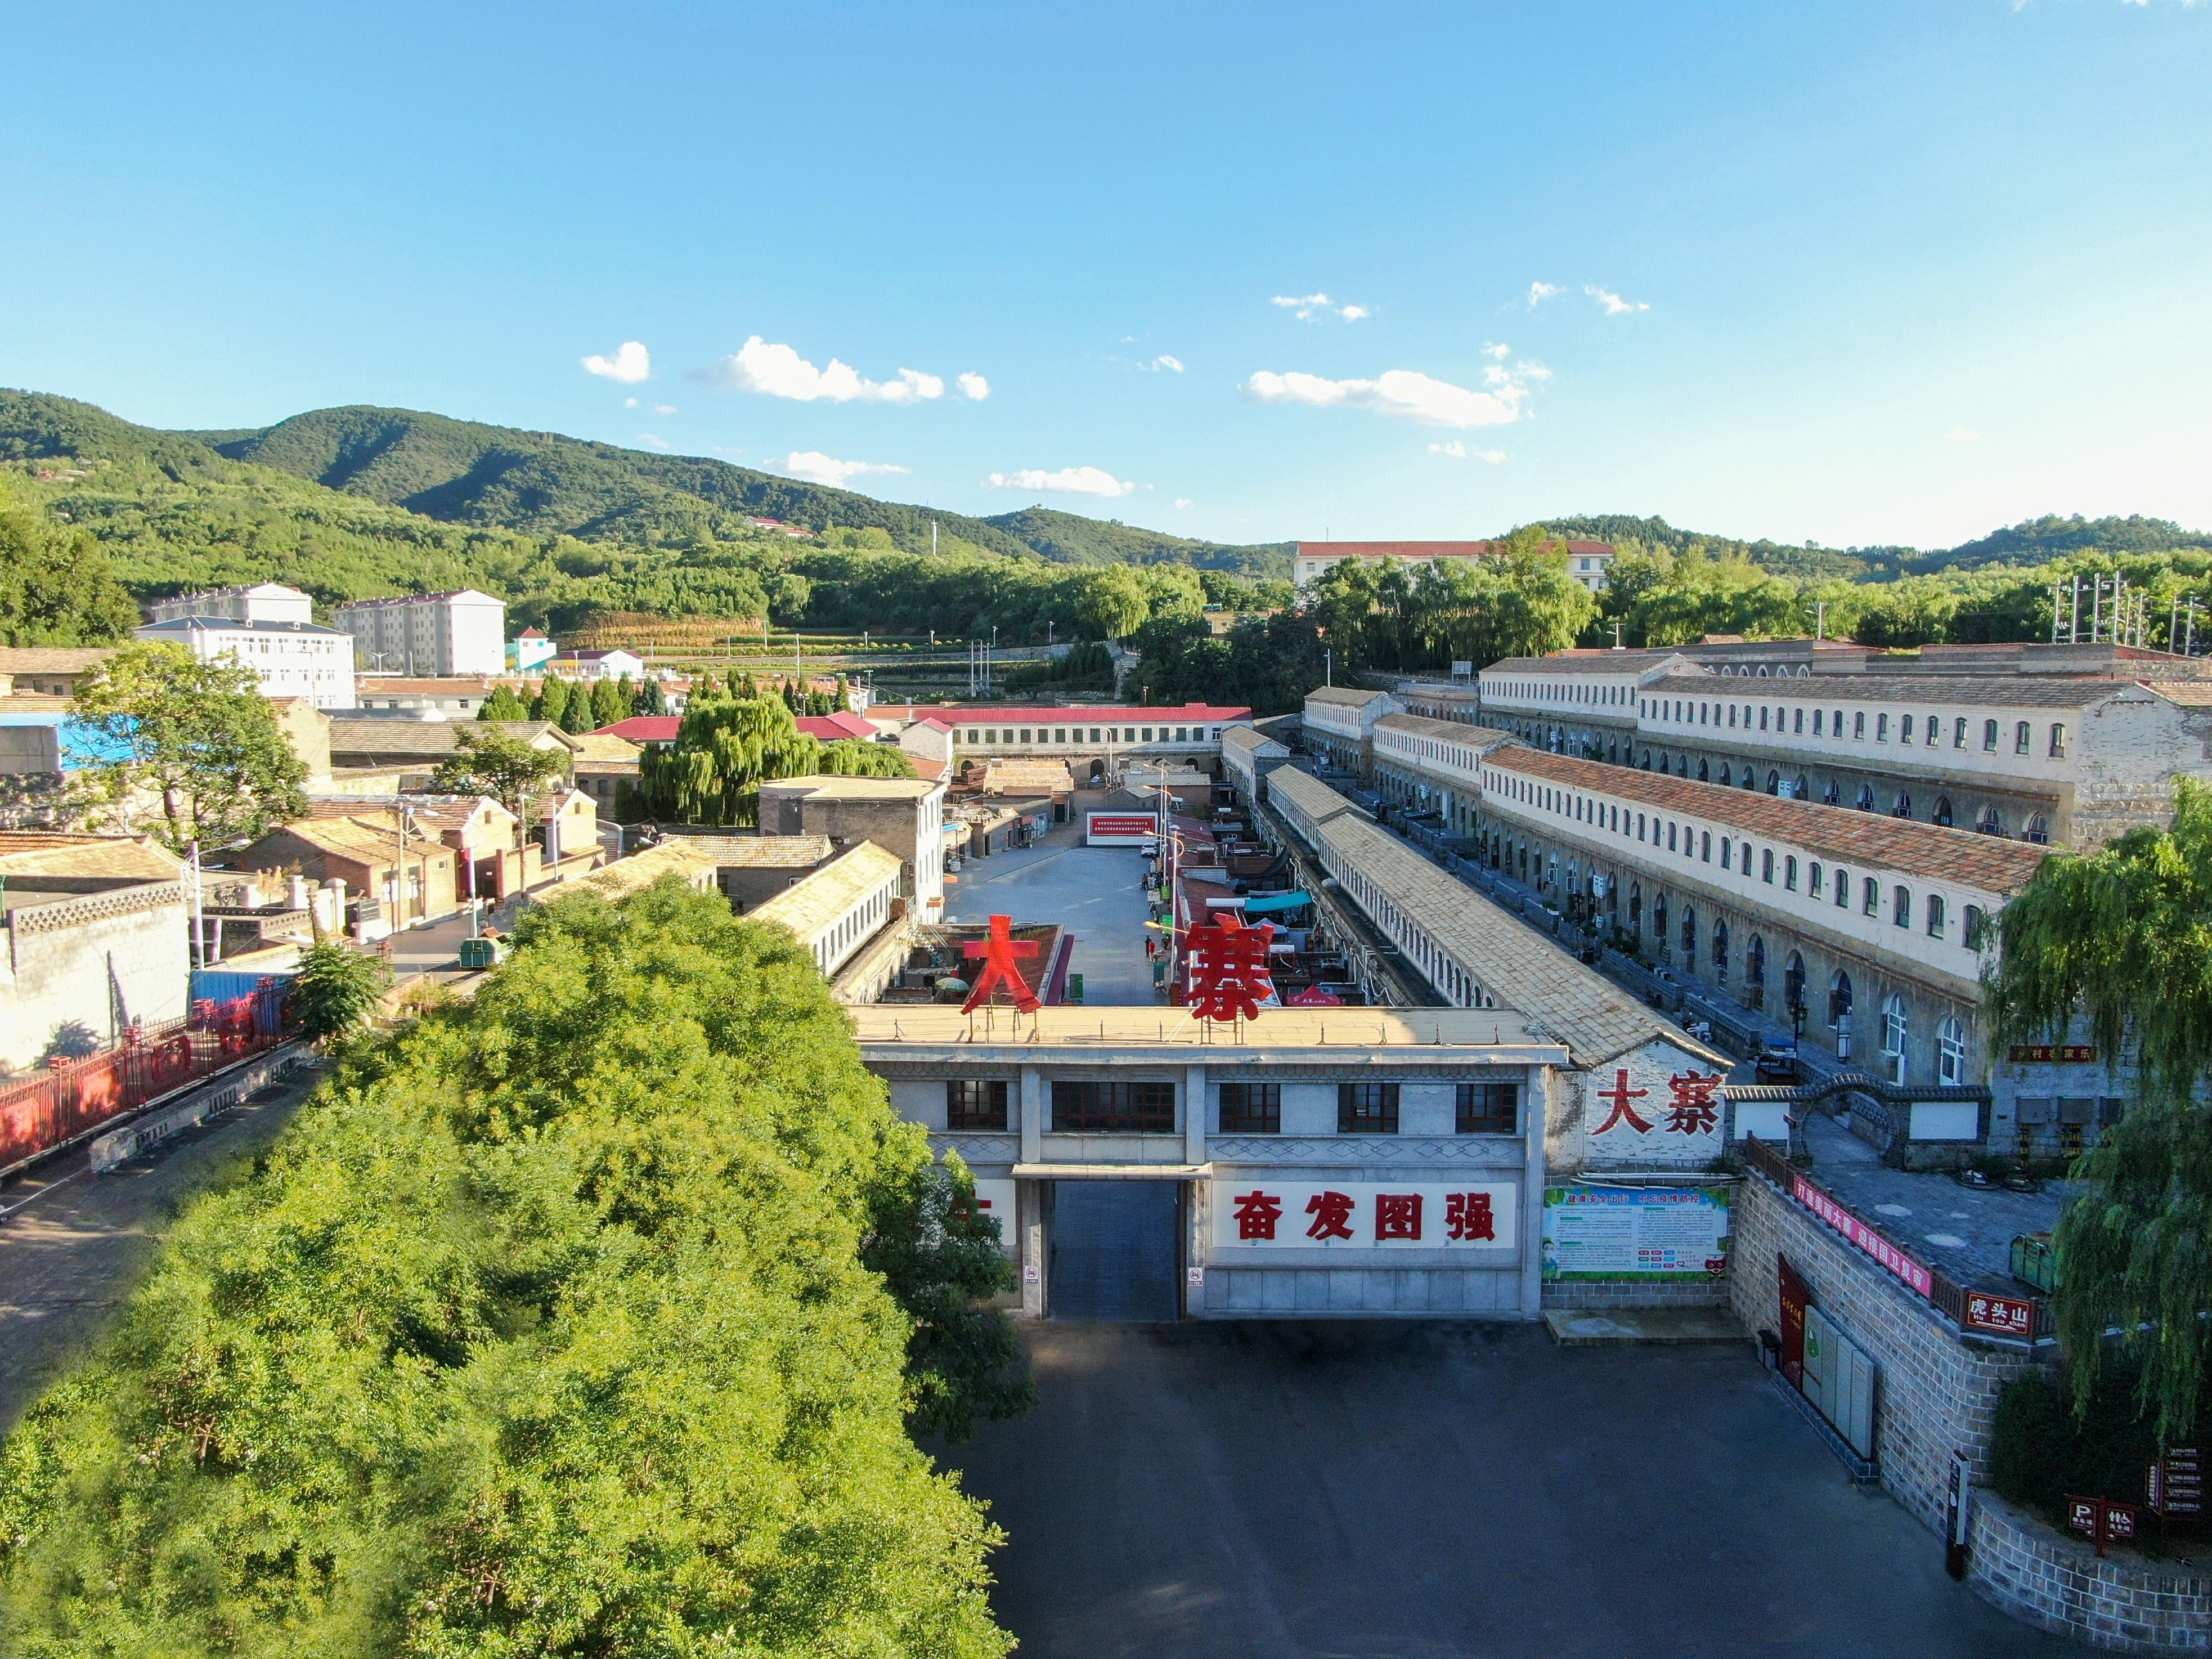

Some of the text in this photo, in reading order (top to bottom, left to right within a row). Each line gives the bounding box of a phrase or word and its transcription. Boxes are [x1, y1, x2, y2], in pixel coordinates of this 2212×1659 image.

[960, 913, 1275, 1021] 大寨
[1592, 1069, 1722, 1136] 大寨
[1232, 1190, 1496, 1241] 奋发图强
[1568, 1194, 1700, 1203] 健康安全出行 不忘疫情防控
[1798, 1183, 1923, 1287] 打造美丽大寨 迎接国卫复审
[1970, 1298, 2027, 1322] 虎头山
[2076, 1505, 2091, 1517] P
